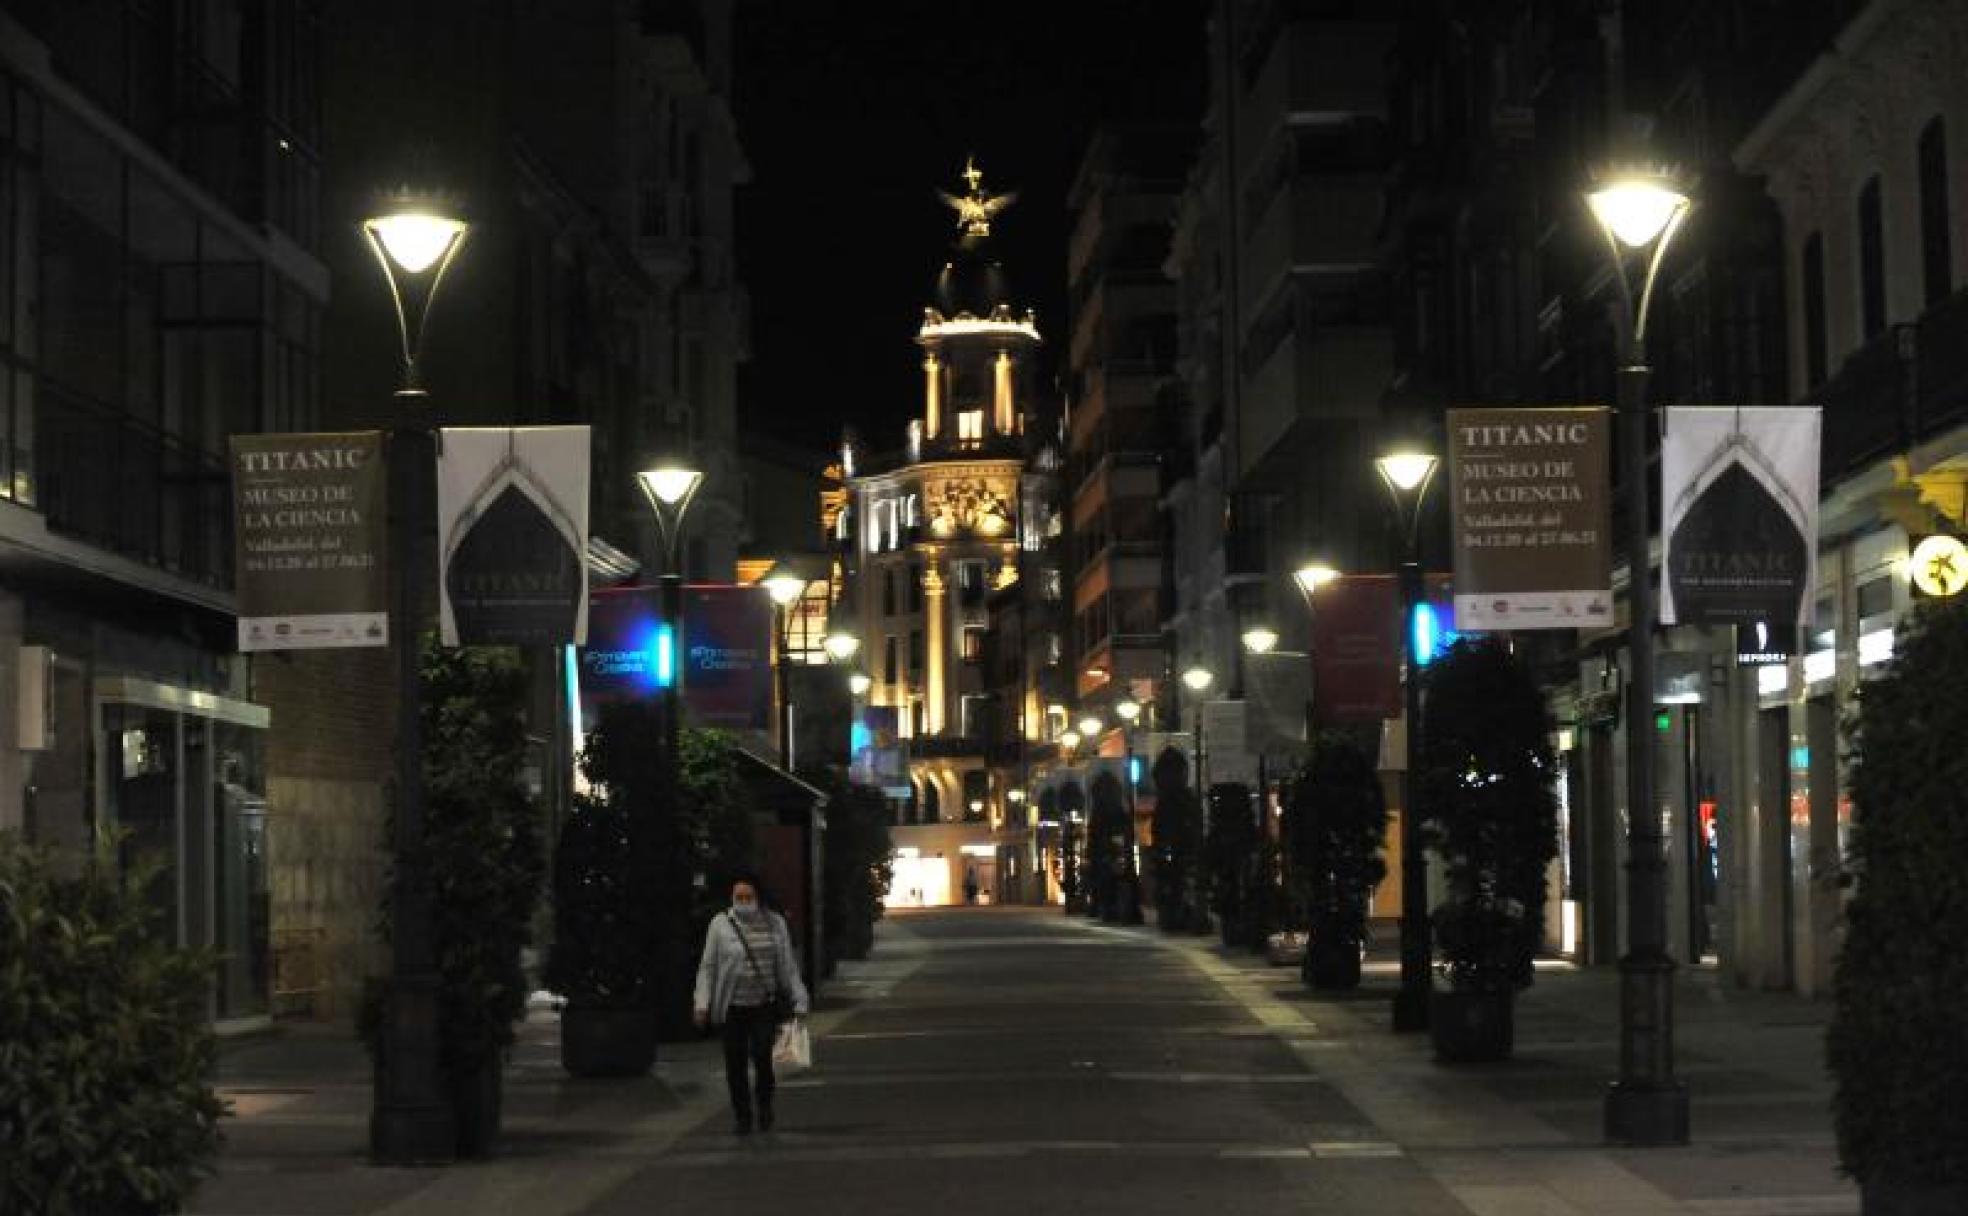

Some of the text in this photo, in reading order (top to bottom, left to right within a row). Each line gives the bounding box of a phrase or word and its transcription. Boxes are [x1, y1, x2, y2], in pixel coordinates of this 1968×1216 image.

[1460, 424, 1587, 446] TITANIC
[240, 448, 366, 472] TITANIC
[1463, 461, 1575, 480] MUSEO DE
[245, 485, 349, 504] MUSEO DE
[1465, 485, 1583, 504] LA CIENCIA
[245, 508, 360, 528] LA CIENCIA
[1682, 551, 1791, 573] TITANIC
